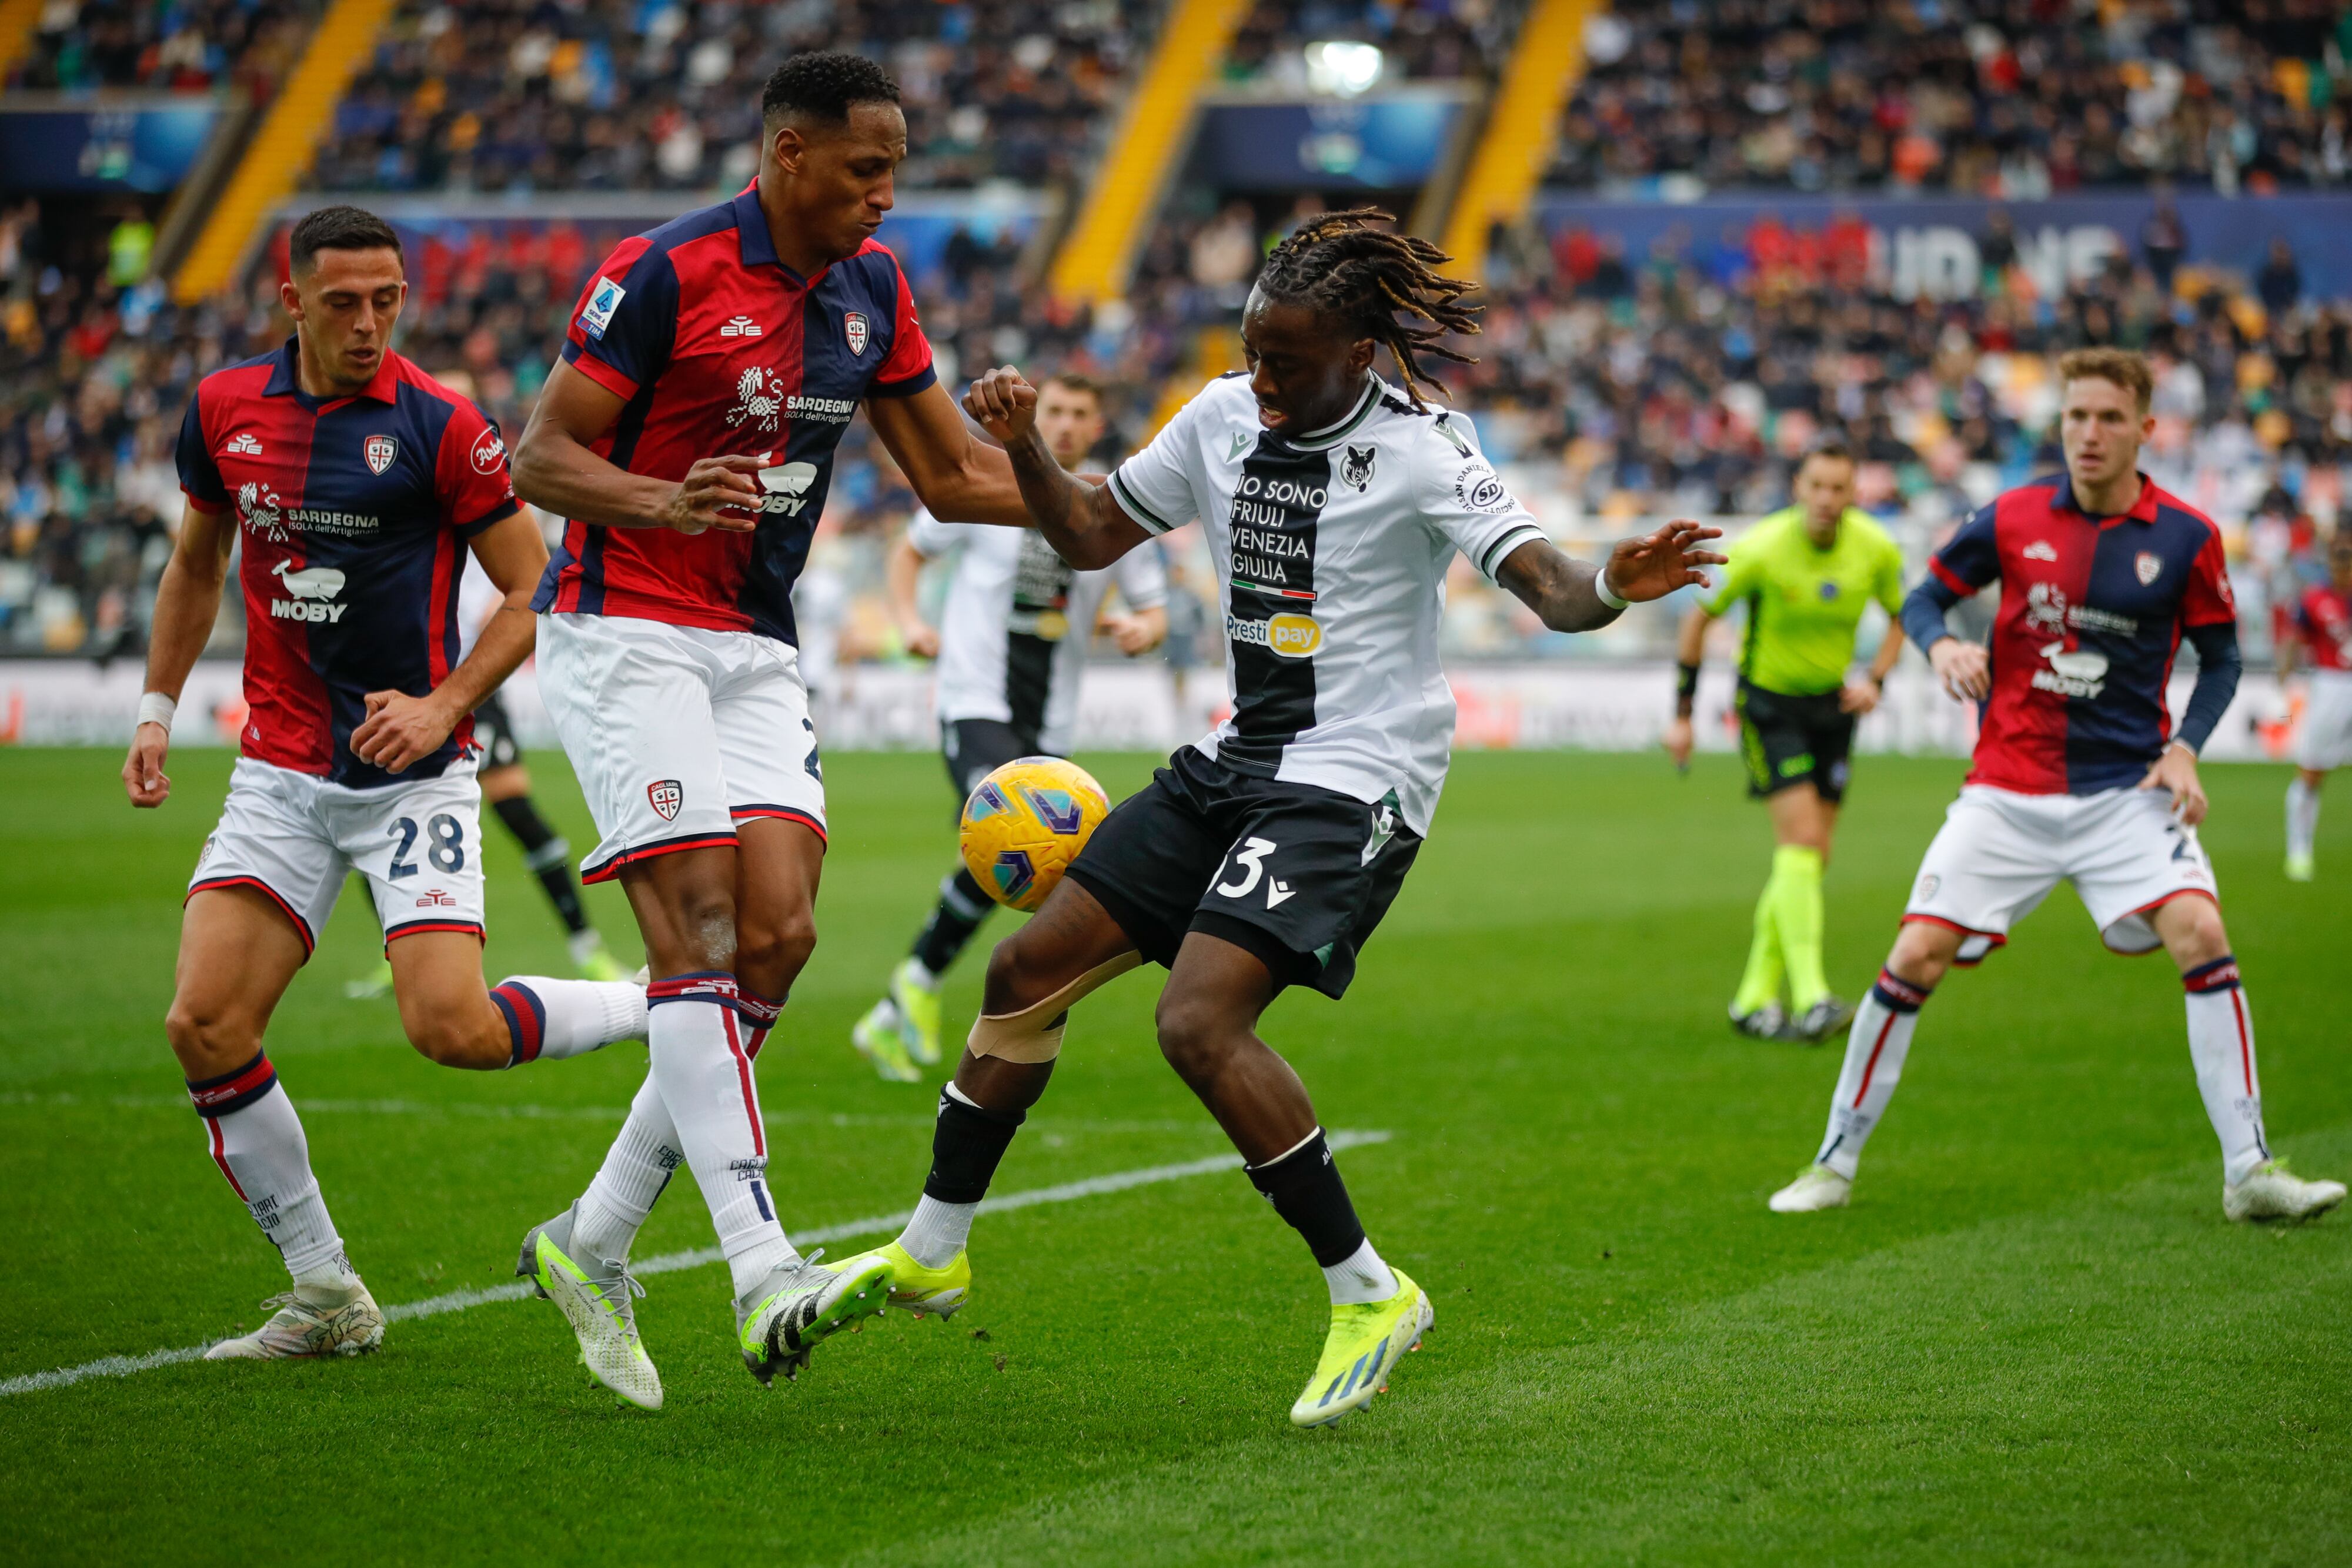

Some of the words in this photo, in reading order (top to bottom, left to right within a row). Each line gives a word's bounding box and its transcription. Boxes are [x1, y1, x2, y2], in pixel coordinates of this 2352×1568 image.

[587, 309, 603, 321] SERIE
[588, 323, 601, 337] TIM
[787, 396, 854, 413] SARDEGNA
[1235, 475, 1261, 496] IO
[1264, 481, 1327, 509] SONO
[1455, 484, 1466, 503] SAN
[1479, 483, 1498, 502] SD
[288, 509, 379, 528] SARDEGNA
[1231, 499, 1285, 527] FRIULI
[289, 521, 313, 531] ISOLA
[1230, 525, 1309, 559] VENEZIA
[1232, 553, 1287, 583] GIULIA
[271, 598, 348, 623] MOBY
[2031, 668, 2105, 700] MOBY
[651, 782, 679, 791] CAGLIARI
[387, 814, 465, 882] 28
